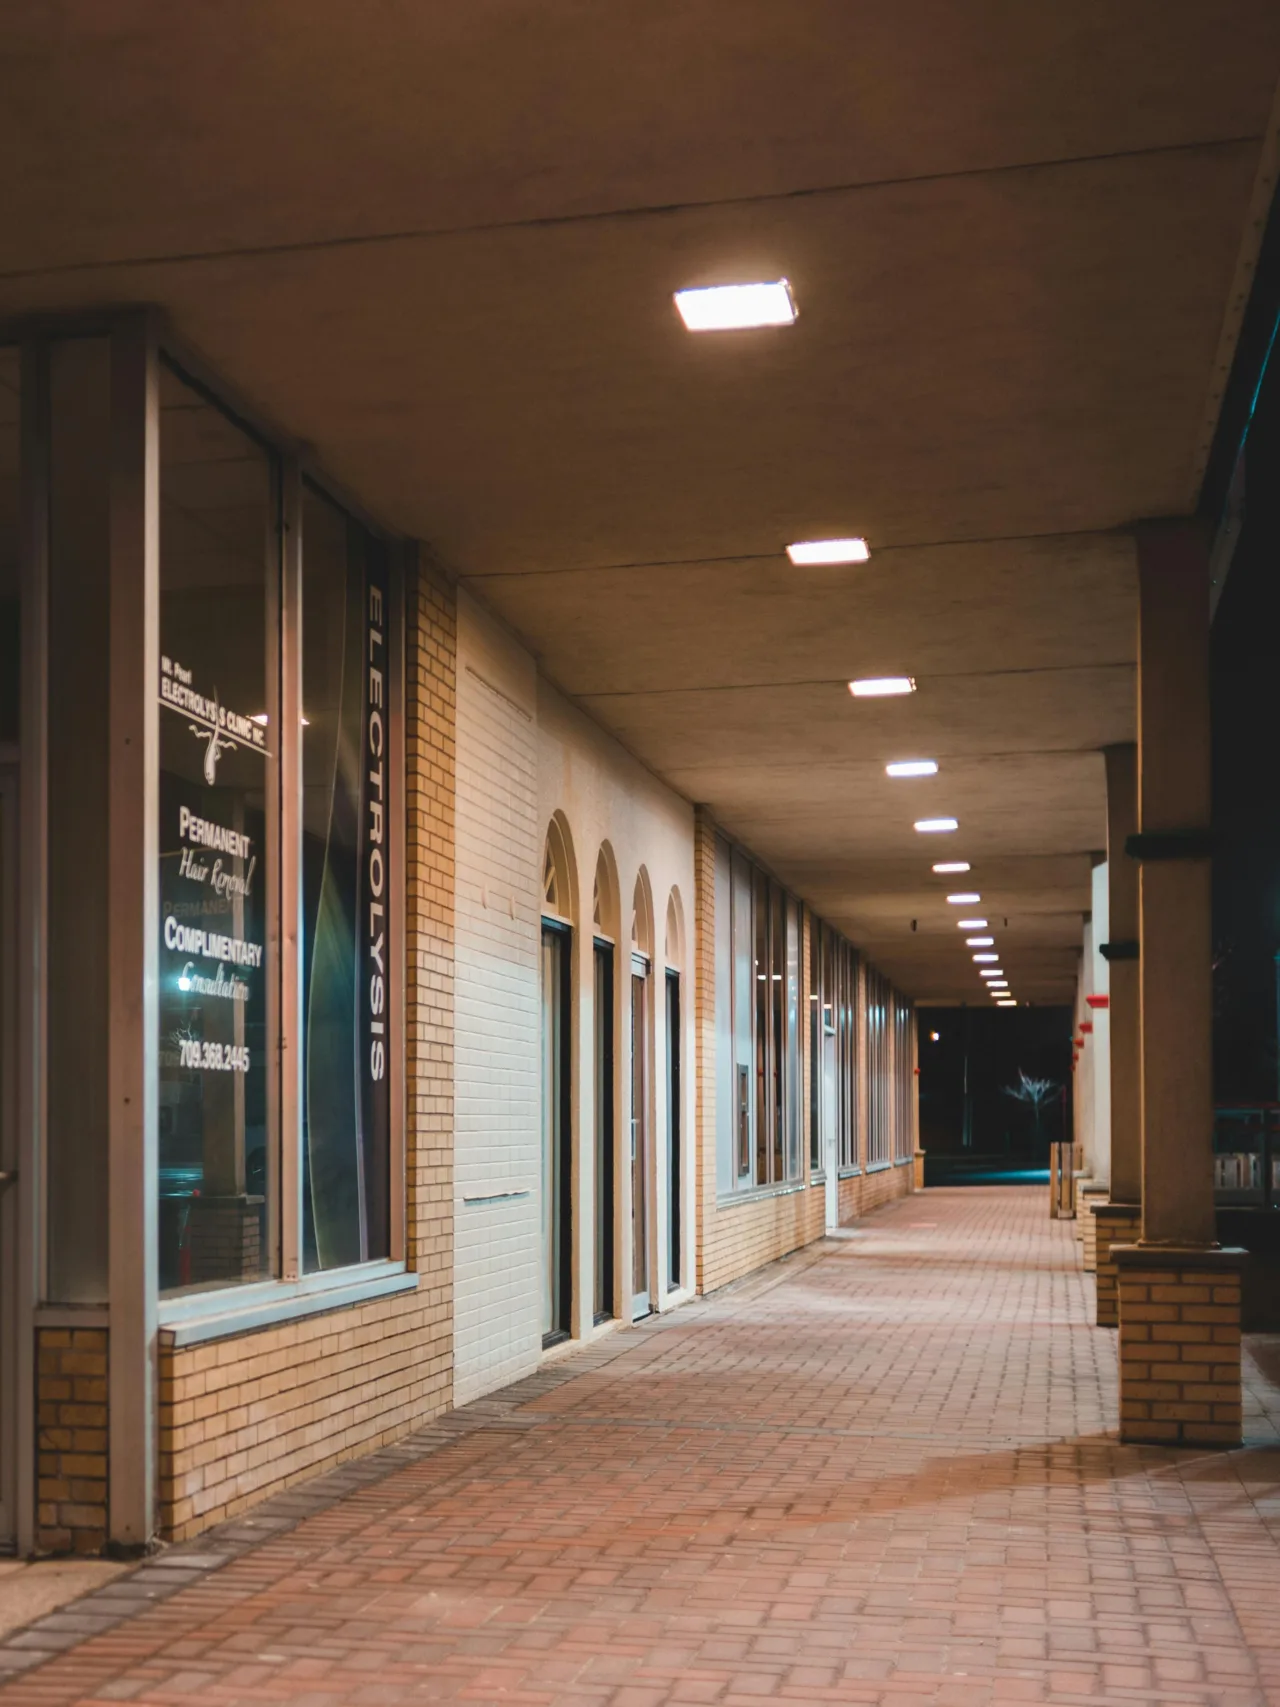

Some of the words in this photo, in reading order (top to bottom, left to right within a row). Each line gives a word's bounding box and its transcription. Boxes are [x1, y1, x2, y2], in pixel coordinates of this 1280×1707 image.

[180, 805, 251, 859] PERMANENT
[369, 585, 385, 1082] ELECTROLYSIS
[179, 847, 209, 881] Hair
[164, 916, 263, 967] COMPLIMENTARY
[179, 1039, 250, 1073] 709.368.2445
